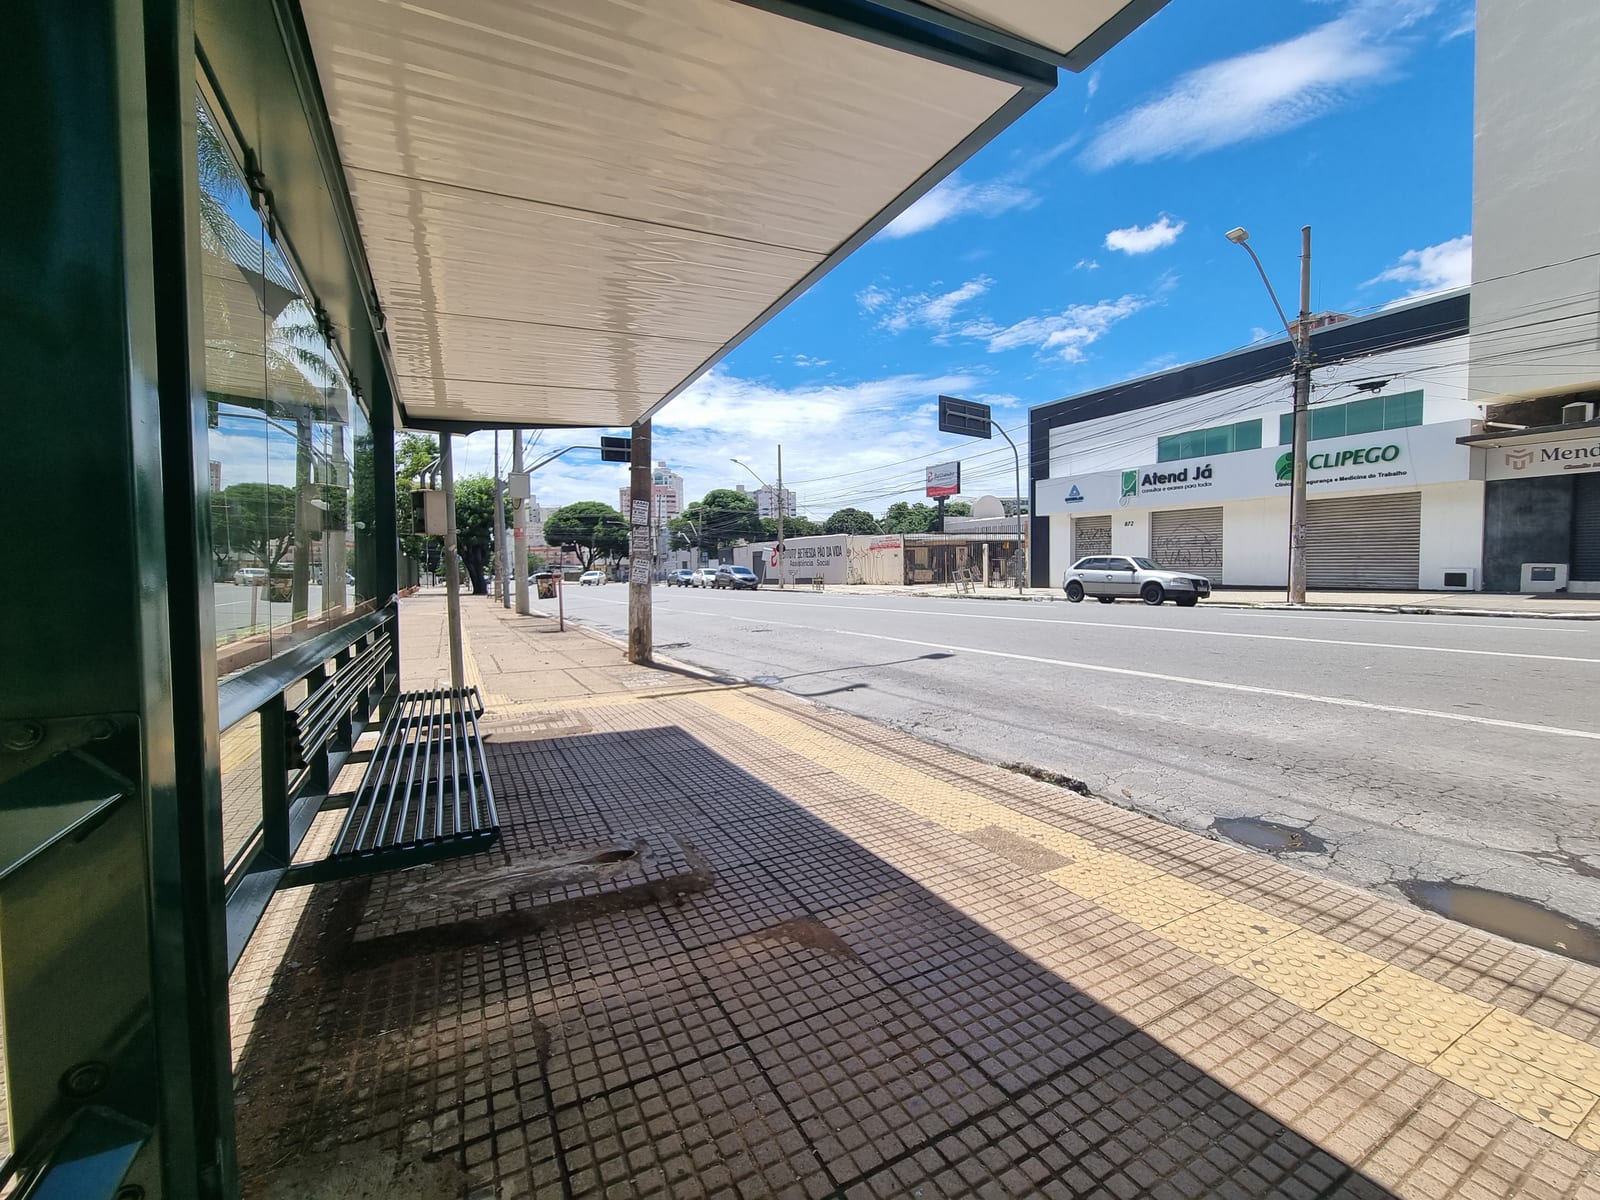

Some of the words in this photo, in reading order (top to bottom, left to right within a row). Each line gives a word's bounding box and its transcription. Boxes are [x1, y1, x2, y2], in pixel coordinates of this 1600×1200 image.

[1309, 445, 1400, 470] CLIPEGO
[1141, 468, 1188, 487] Atend
[1192, 463, 1213, 481] Já
[1378, 470, 1407, 478] Trabalho
